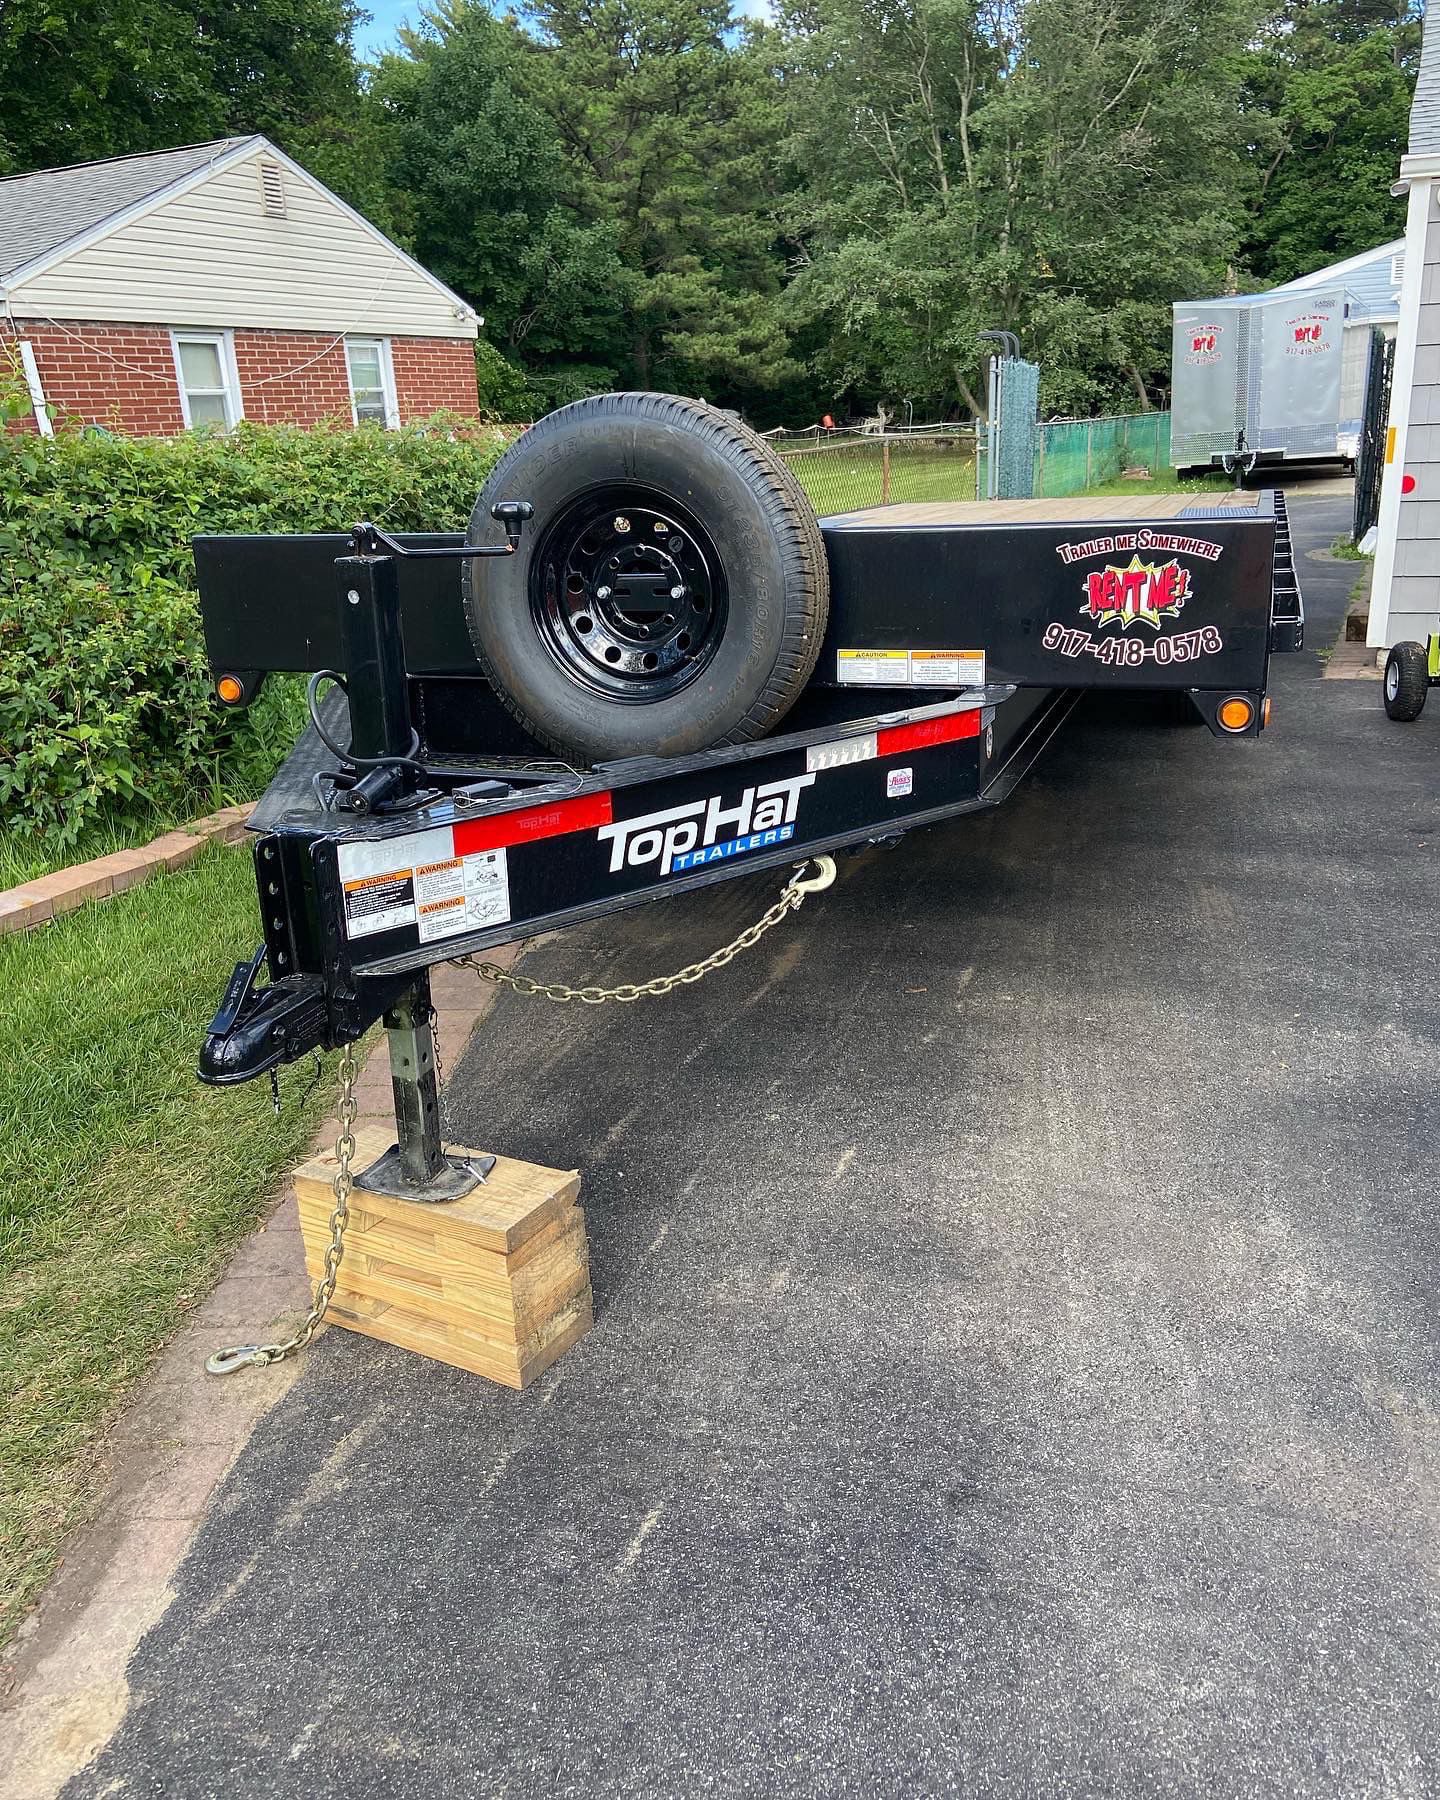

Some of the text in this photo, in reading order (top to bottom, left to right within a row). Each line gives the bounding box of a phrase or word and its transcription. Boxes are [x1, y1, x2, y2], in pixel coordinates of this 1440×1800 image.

[1088, 570, 1148, 616] RENT
[1043, 622, 1222, 666] 917-418-0578
[676, 825, 793, 869] TRAILERS
[366, 875, 397, 886] WARNING
[425, 860, 458, 873] WARNING
[427, 898, 460, 911] WARNING
